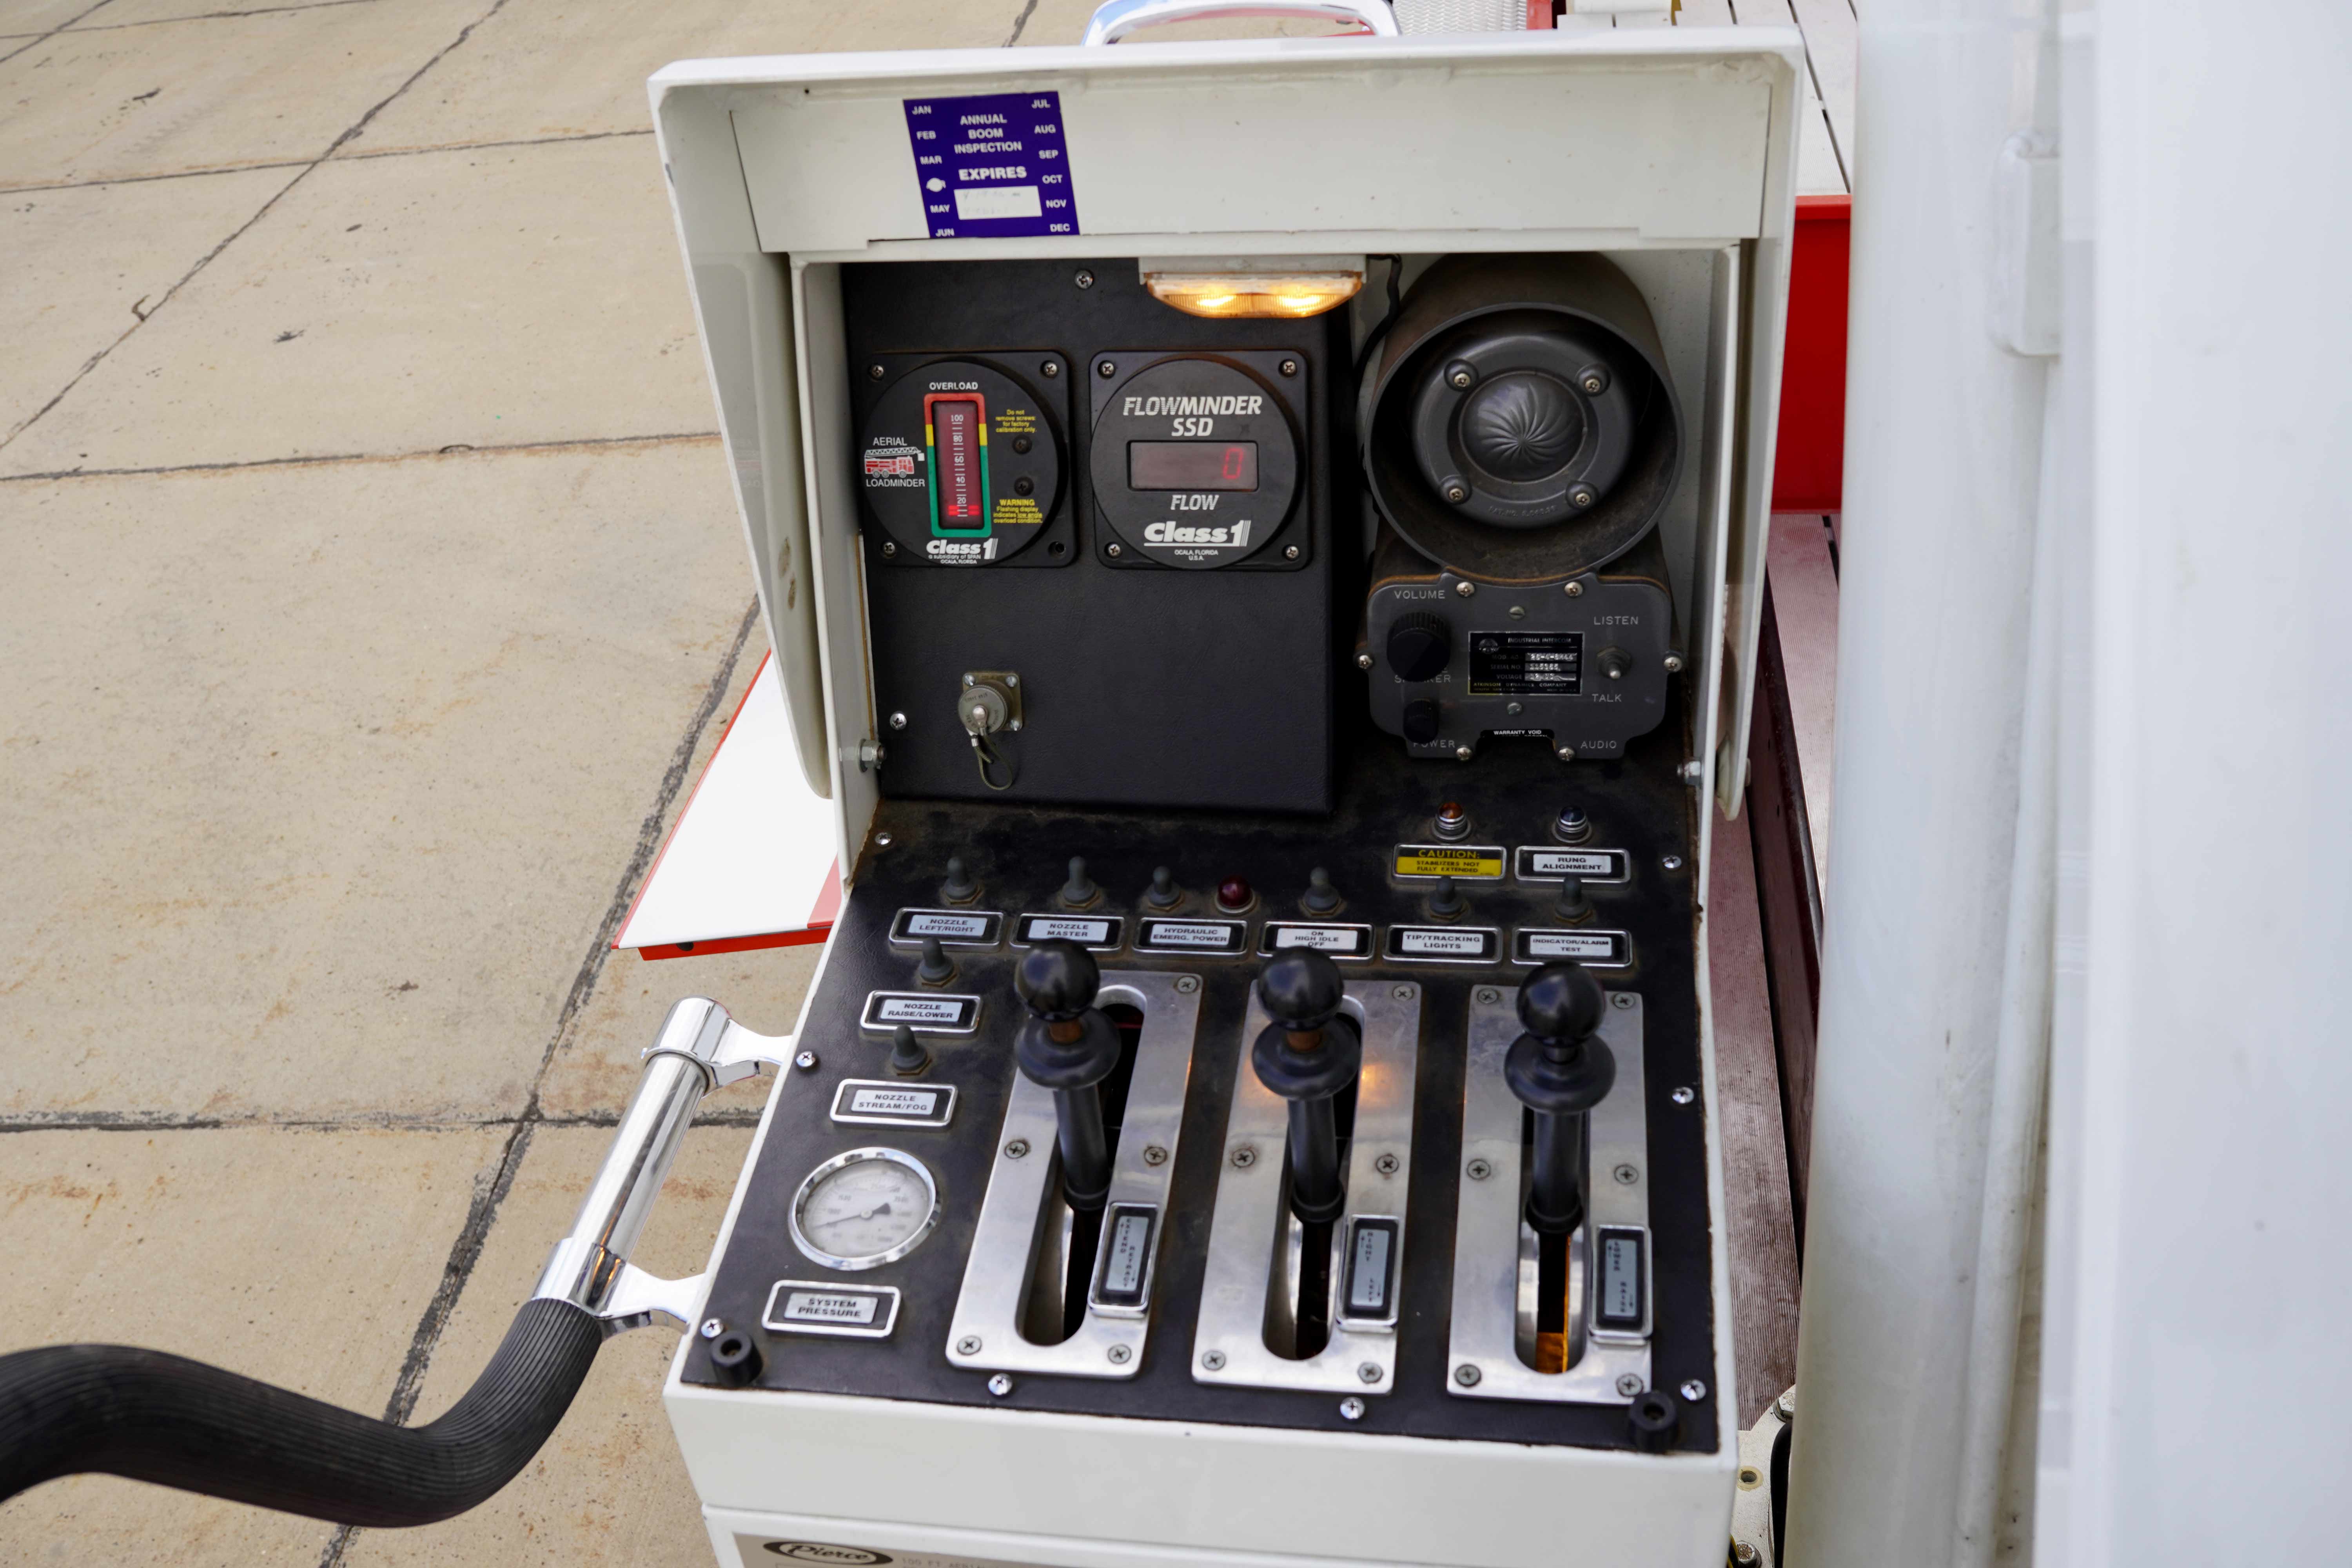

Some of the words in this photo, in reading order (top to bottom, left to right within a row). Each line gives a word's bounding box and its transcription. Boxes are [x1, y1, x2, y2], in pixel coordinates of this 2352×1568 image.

[1032, 99, 1050, 108] JUL
[912, 106, 931, 114] JAN
[960, 114, 1007, 125] ANNUAL
[968, 128, 1003, 139] BOOM
[1034, 125, 1056, 134] AUG
[917, 131, 936, 140] FEB
[954, 142, 1022, 154] INSPECTION
[1039, 150, 1058, 159] SEP
[920, 156, 942, 165] MAR
[958, 166, 1027, 181] EXPIRES
[1042, 175, 1062, 184] OCT
[1046, 200, 1066, 208] NOV
[930, 205, 950, 213] MAY
[1050, 223, 1070, 232] DEC
[936, 229, 954, 237] JUN
[929, 382, 978, 390] OVERLOAD
[1123, 396, 1263, 416] FLOWMINDER
[1171, 418, 1214, 437] SSD
[873, 437, 907, 446] AERIAL
[1222, 448, 1244, 480] 0
[866, 479, 925, 487] LOADMINDER
[1171, 495, 1219, 510] FLOW
[1394, 590, 1445, 599] VOLUME
[1593, 616, 1639, 625] LISTEN
[1591, 693, 1622, 702] TALK
[1580, 740, 1617, 749] AUDIO
[1418, 849, 1480, 859] CAUTION:
[1406, 934, 1480, 942] TIP/TRACKING
[888, 1010, 953, 1018] RAISE/LOWER
[858, 1102, 927, 1110] STREAM/FOG
[808, 1298, 856, 1307] SYSTEM
[798, 1307, 861, 1317] PRESSURE
[788, 1545, 869, 1560] Pierce
